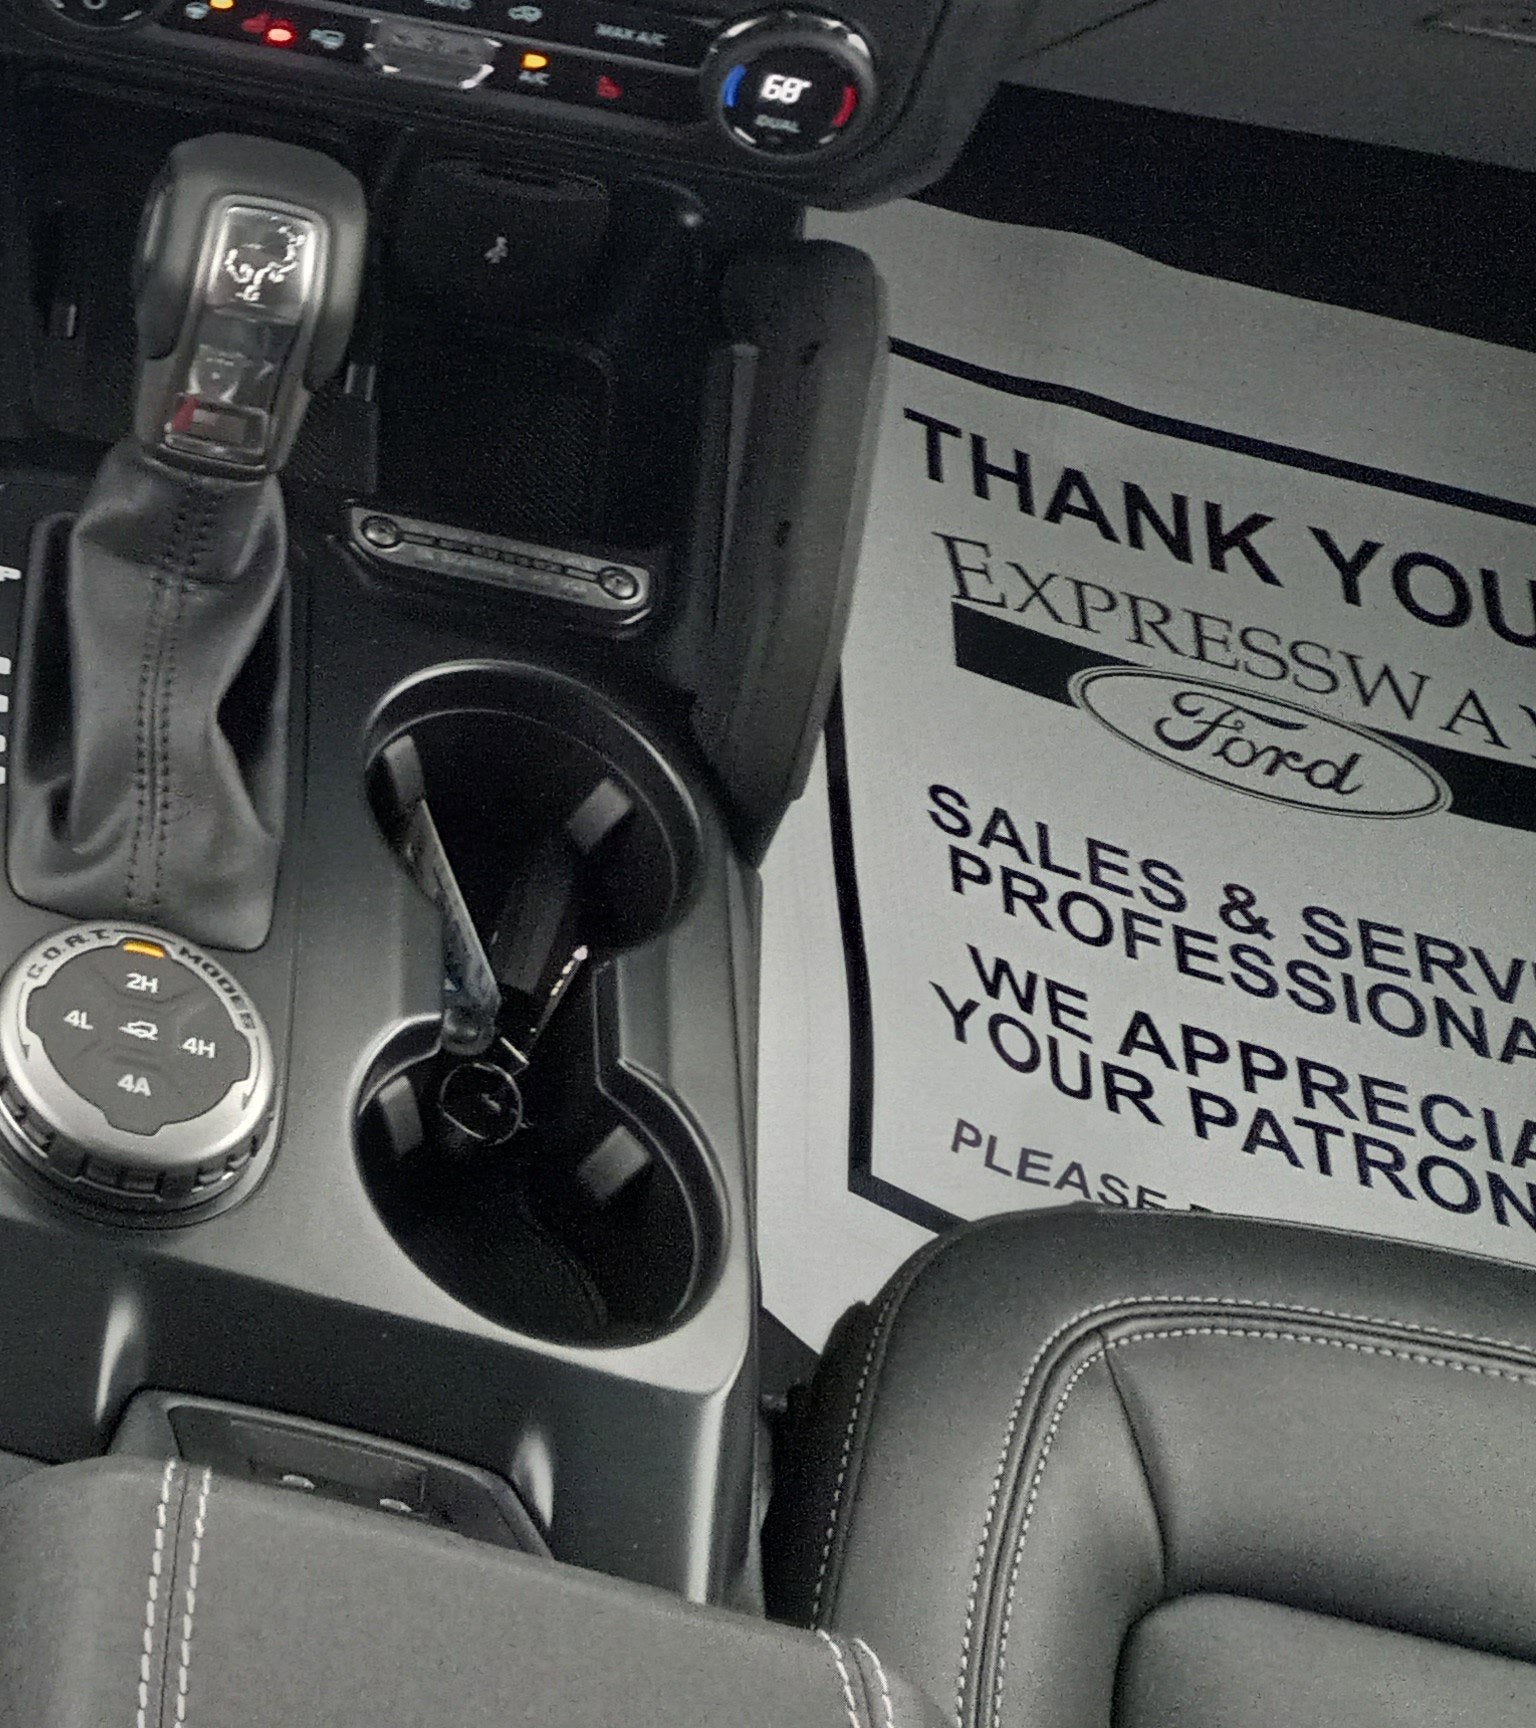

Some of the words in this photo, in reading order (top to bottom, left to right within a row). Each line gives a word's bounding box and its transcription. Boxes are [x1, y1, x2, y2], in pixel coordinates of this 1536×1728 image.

[901, 406, 1285, 588] THANK
[1306, 524, 1536, 650] YOU
[932, 531, 1536, 759] EXPRESSWA
[1153, 690, 1365, 797] Ford
[928, 783, 1189, 914] SALES
[1218, 883, 1275, 940] &
[1299, 905, 1536, 1005] SERV
[63, 1009, 94, 1030] 4L
[125, 972, 159, 994] 2H
[967, 943, 1093, 1042] WE
[117, 1073, 152, 1097] 4A
[181, 1036, 216, 1059] 4H
[927, 979, 1166, 1126] YOUR
[950, 1118, 1167, 1210] PLEASE
